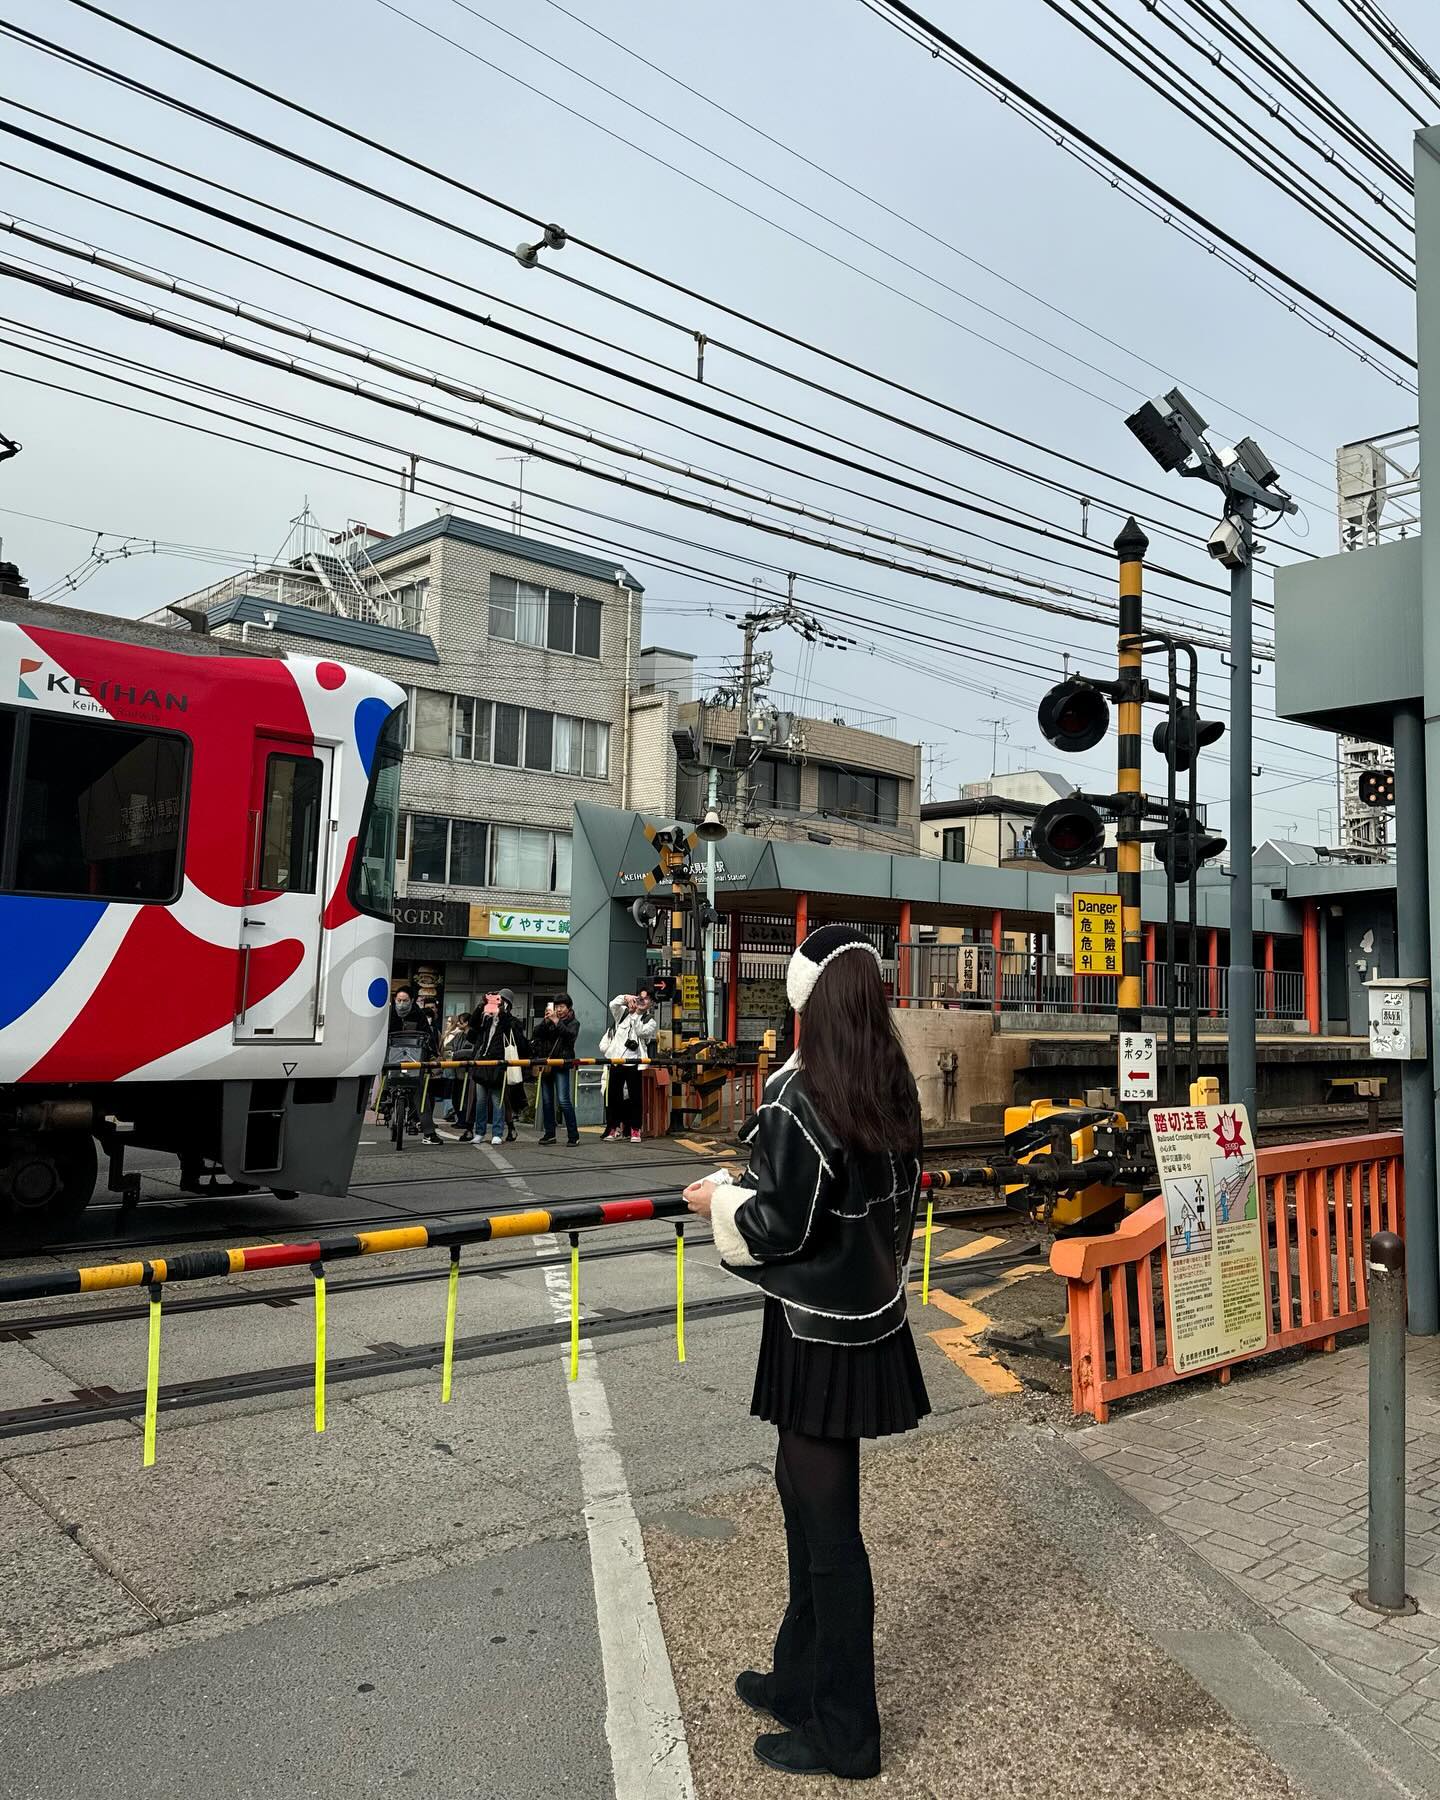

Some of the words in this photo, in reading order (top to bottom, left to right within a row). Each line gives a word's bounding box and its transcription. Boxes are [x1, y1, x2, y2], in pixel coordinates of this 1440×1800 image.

[624, 872, 649, 881] KEIHA
[1078, 899, 1118, 915] Danger
[1081, 954, 1116, 970] 위험
[963, 949, 974, 990] 伏見稲荷
[1125, 1037, 1153, 1048] 非常
[1124, 1049, 1153, 1060] ボタン
[1124, 1089, 1154, 1098] むこう側
[1153, 1110, 1208, 1133] 踏切注意
[1157, 1134, 1175, 1142] Railroad
[1176, 1133, 1193, 1142] Crossing
[1194, 1132, 1211, 1140] Warning
